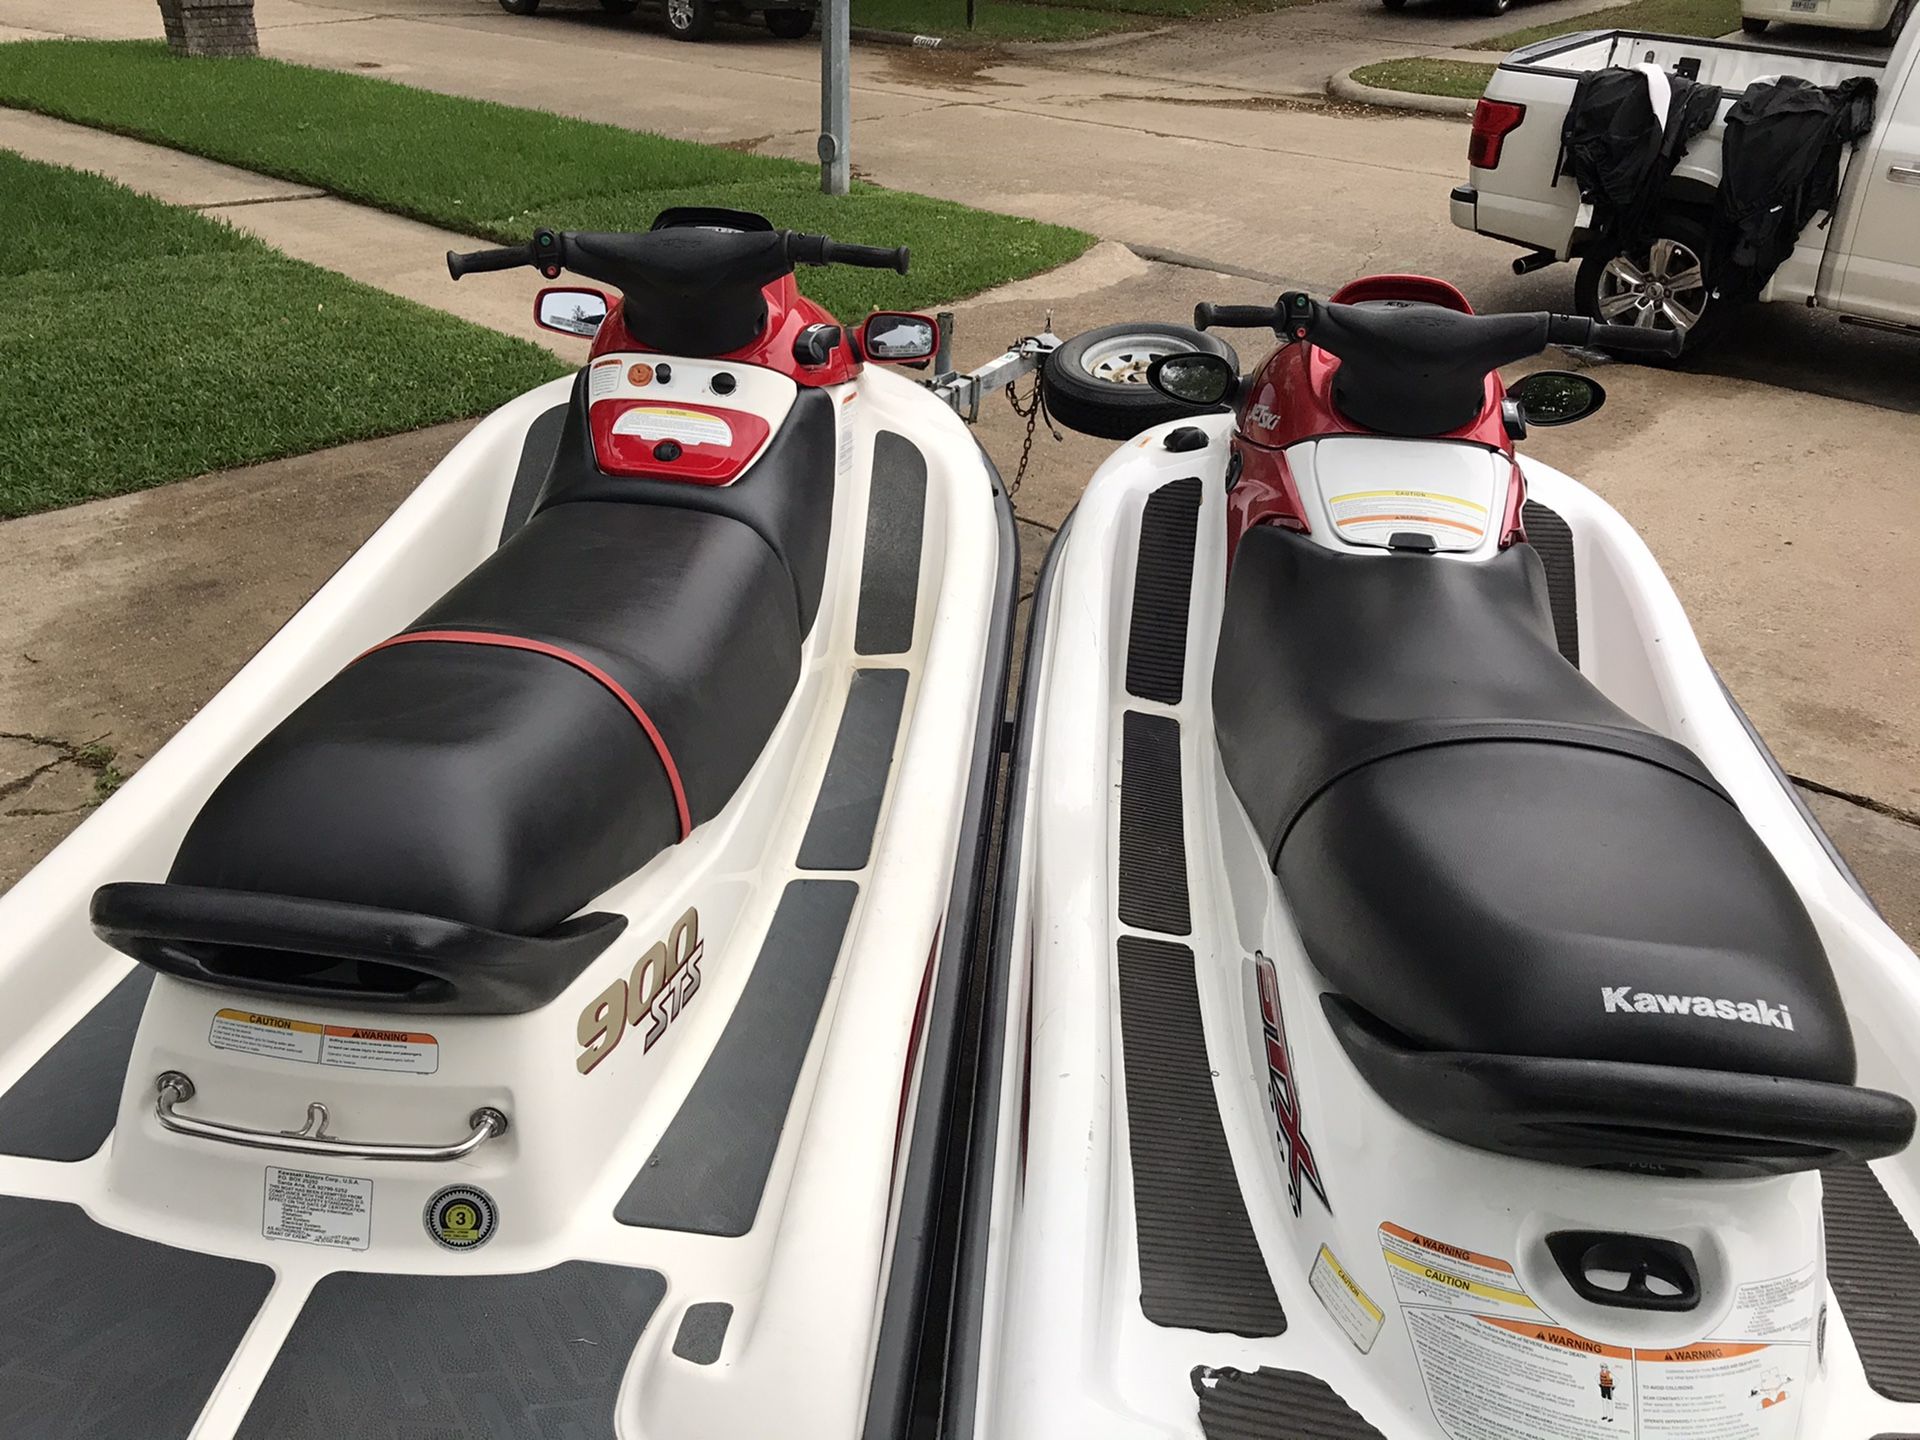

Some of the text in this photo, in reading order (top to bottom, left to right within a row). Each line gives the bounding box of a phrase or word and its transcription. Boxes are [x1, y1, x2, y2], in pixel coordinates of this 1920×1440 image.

[576, 905, 699, 1075] 900
[643, 938, 704, 1056] STS
[1601, 986, 1794, 1031] Kawasaki
[249, 1015, 291, 1029] CAUTION
[360, 1030, 408, 1042] WARNING
[1255, 949, 1333, 1217] STX
[455, 1212, 466, 1226] 3
[1421, 1238, 1470, 1261] WARNING
[1338, 1270, 1360, 1297] CAUTION
[1424, 1268, 1470, 1291] CAUTION
[1548, 1332, 1602, 1354] WARNING
[1674, 1349, 1724, 1361] WARNING
